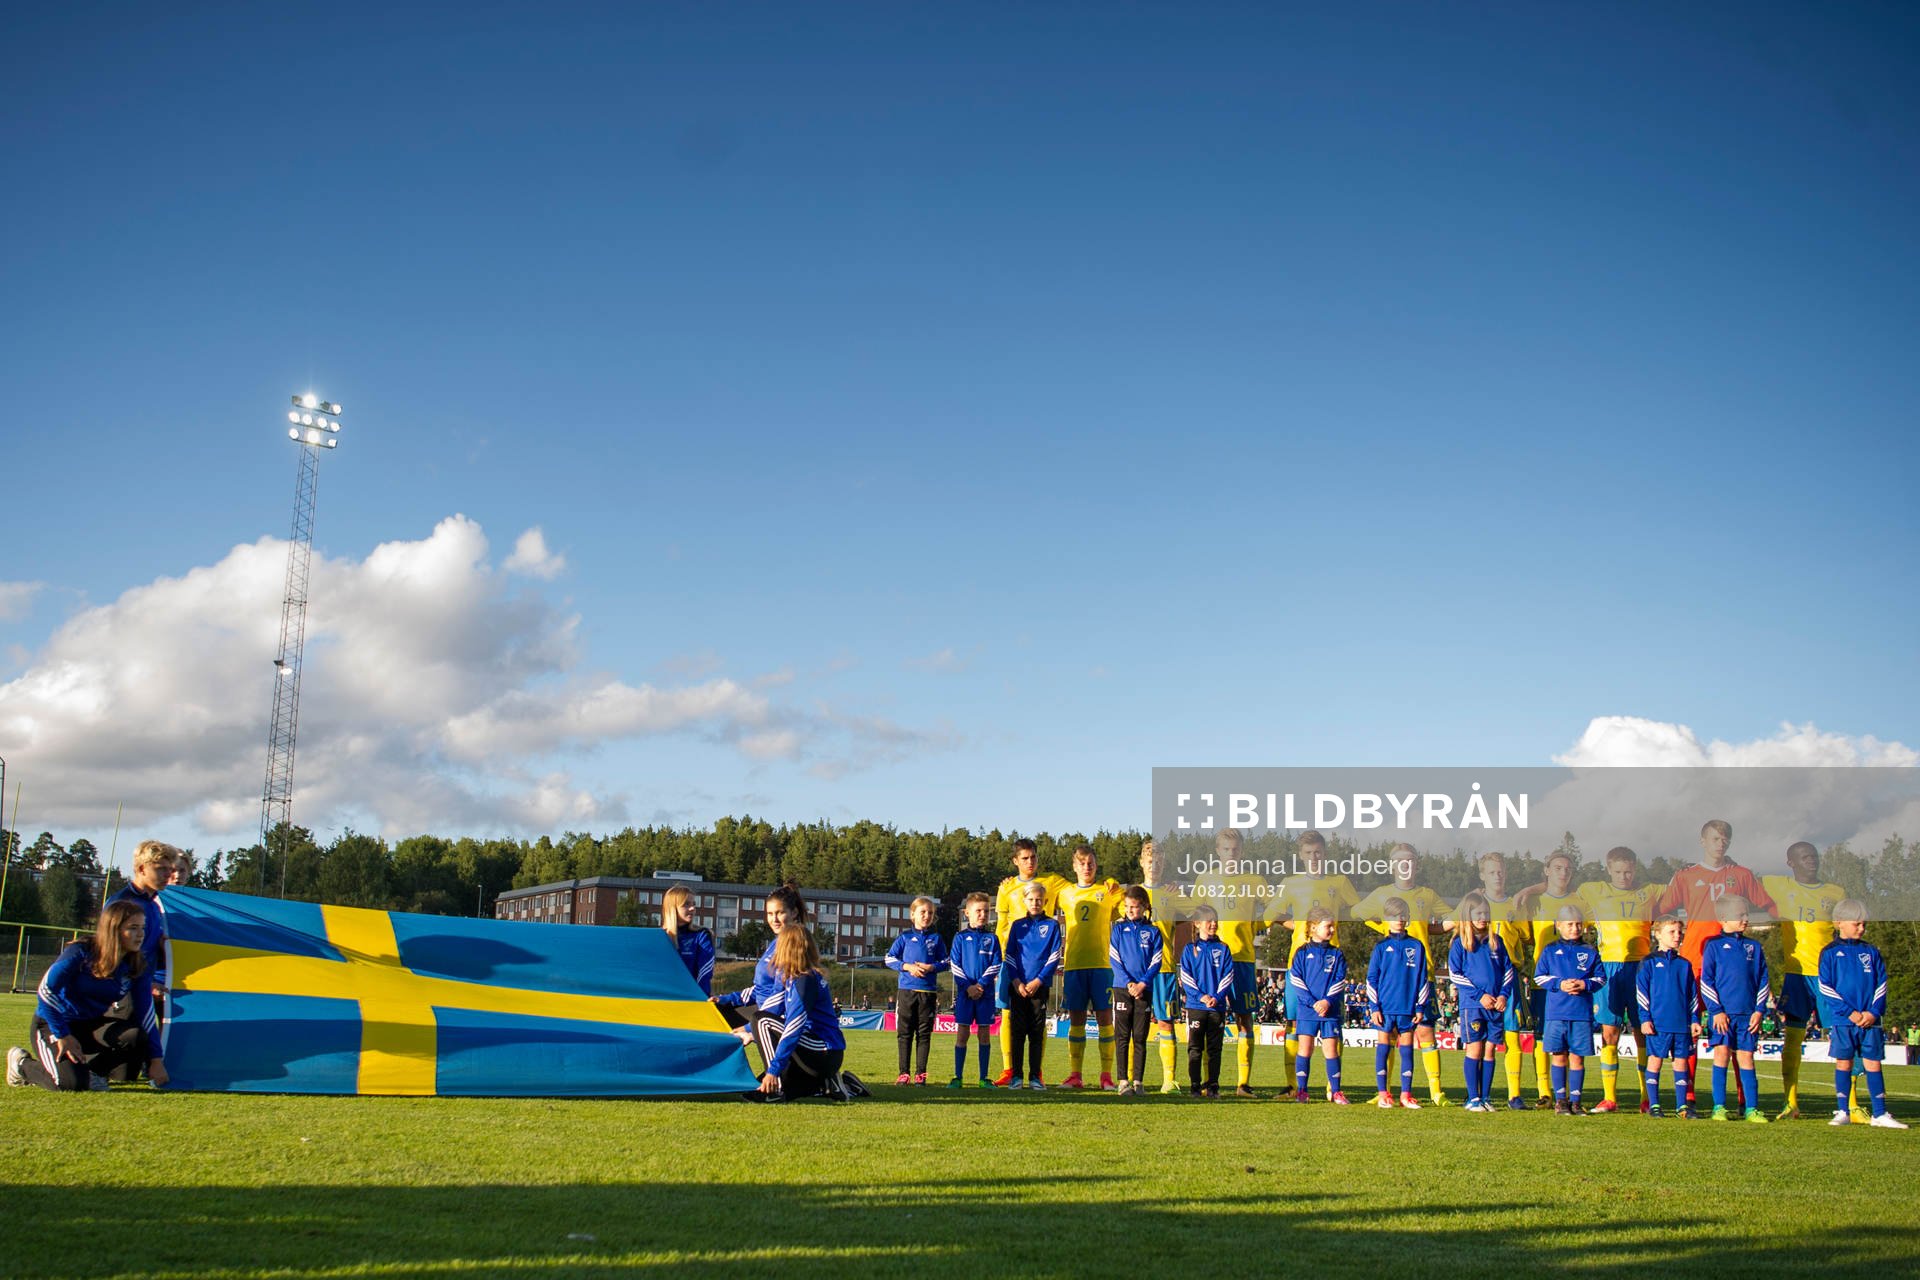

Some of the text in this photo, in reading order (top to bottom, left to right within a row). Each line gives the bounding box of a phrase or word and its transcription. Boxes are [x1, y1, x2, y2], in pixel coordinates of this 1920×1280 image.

[1081, 905, 1090, 921] 2
[1620, 901, 1635, 918] 17
[1798, 906, 1815, 923] 13
[1116, 1002, 1127, 1011] EL
[1189, 1020, 1201, 1029] JS
